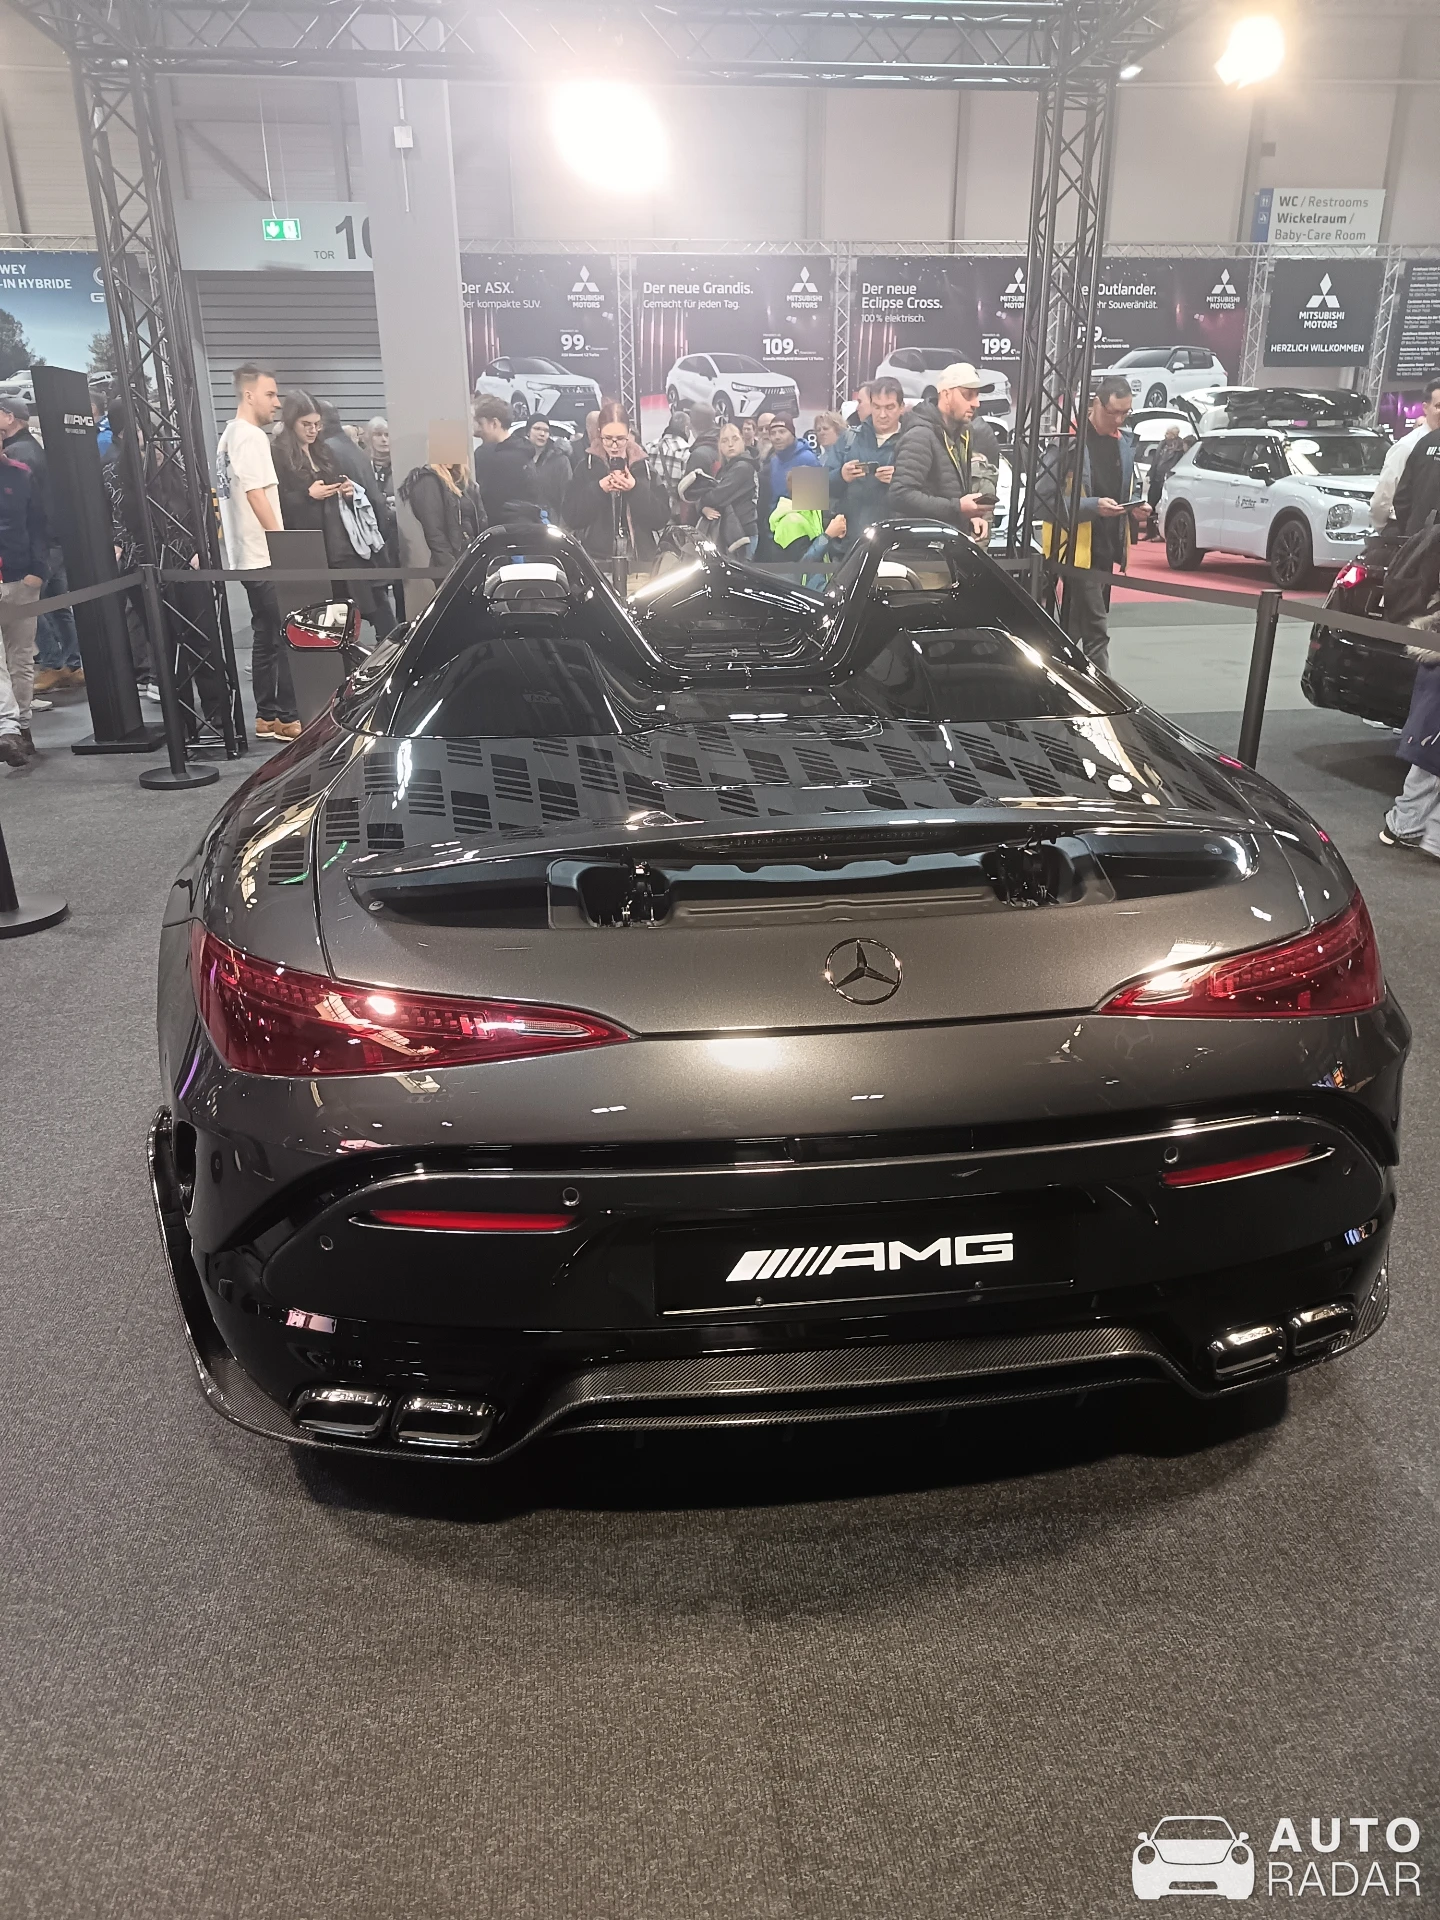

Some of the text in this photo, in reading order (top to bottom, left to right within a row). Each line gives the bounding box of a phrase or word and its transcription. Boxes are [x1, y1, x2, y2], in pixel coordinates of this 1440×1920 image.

[1279, 195, 1299, 207] WC
[1308, 195, 1369, 208] Restrooms
[1277, 212, 1347, 224] Wickelraum
[1274, 228, 1366, 243] Baby-Care Room
[313, 250, 335, 260] TOR
[0, 264, 27, 275] WEY
[18, 278, 73, 289] HYBRIDE
[484, 281, 515, 294] ASX.
[643, 281, 754, 295] Der neue Grandis.
[862, 282, 917, 295] Der neue
[567, 294, 605, 302] MITSUBISHI
[786, 294, 823, 302] MITSUBISHI
[477, 299, 522, 311] kompakte
[572, 301, 601, 309] MOTORS
[643, 299, 740, 311] Gemacht für jeden Tag.
[791, 301, 819, 309] MOTORS
[861, 296, 943, 312] Eclipse Cross.
[1210, 302, 1236, 310] MOTORS
[861, 314, 875, 323] 100
[884, 313, 926, 323] elektrisch.
[1298, 311, 1346, 320] MITSUBISHI
[1303, 320, 1338, 329] MOTORS
[1270, 343, 1365, 353] HERZLICH WILLKOMMEN
